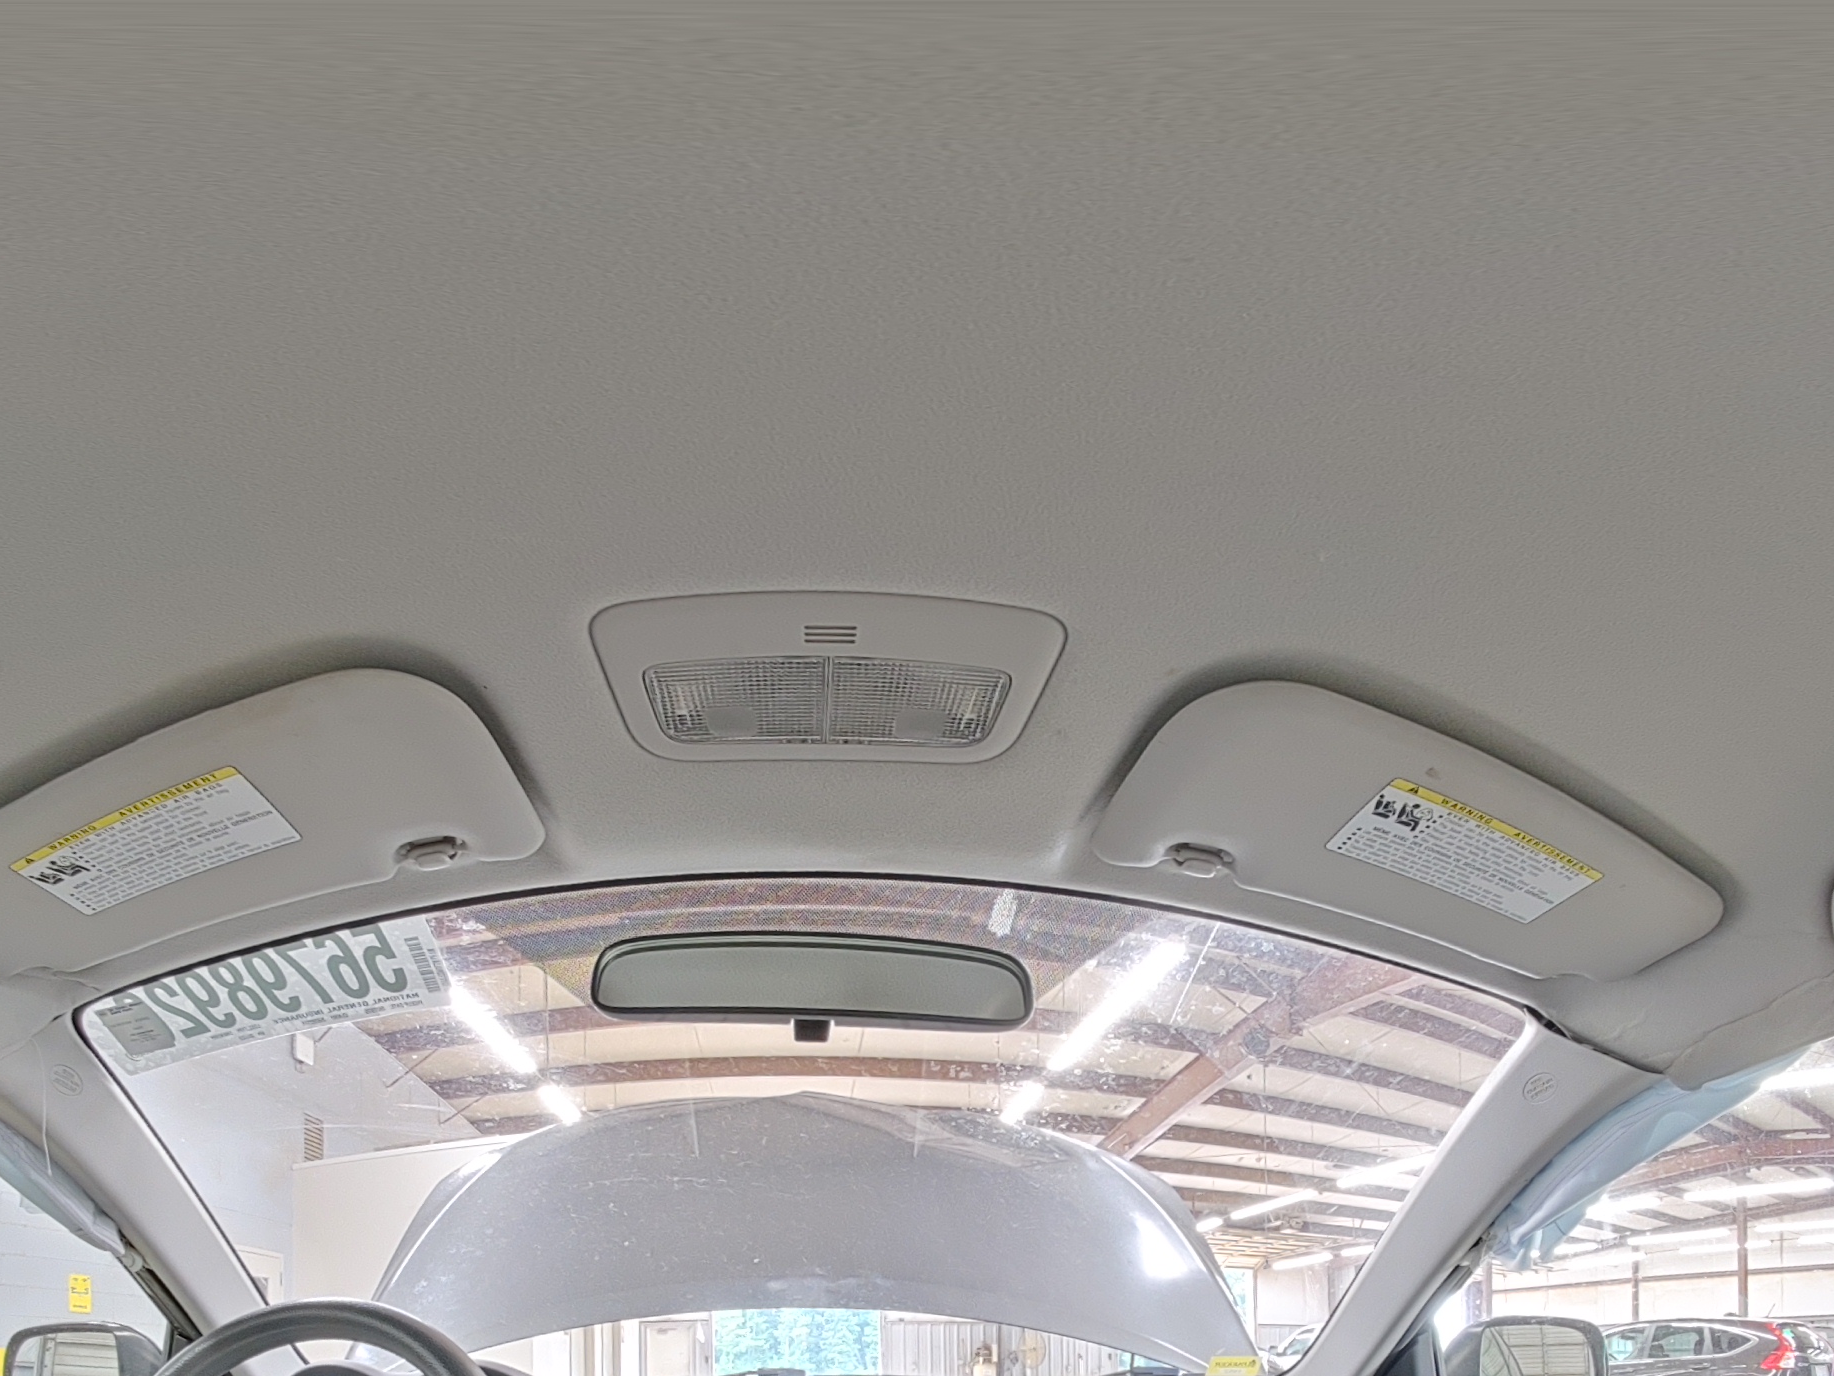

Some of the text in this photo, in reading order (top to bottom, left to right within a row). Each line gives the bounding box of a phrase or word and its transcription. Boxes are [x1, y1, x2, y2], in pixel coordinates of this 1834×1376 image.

[48, 825, 97, 851] WARNING
[118, 773, 218, 818] AVERTISSEMENT
[173, 794, 190, 804] AIR
[195, 782, 223, 796] BAGS
[1441, 798, 1494, 826] WARNING
[1513, 831, 1591, 875] AVERTISSEMENT
